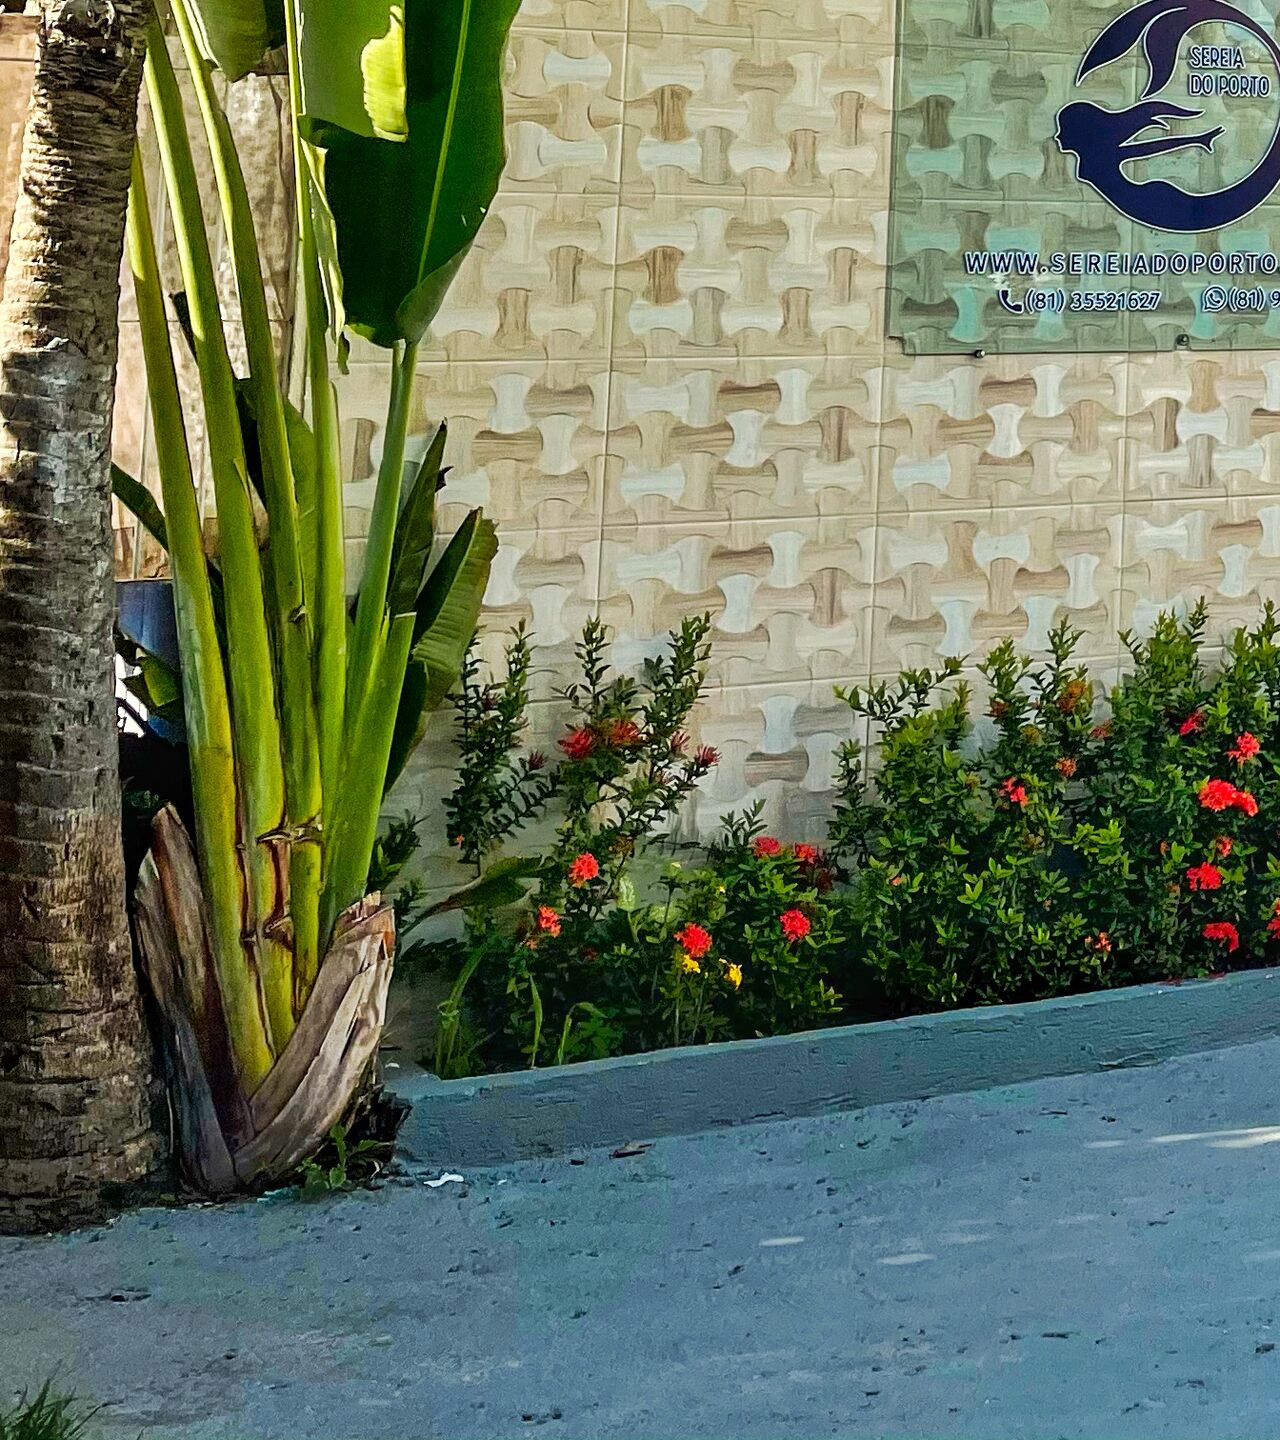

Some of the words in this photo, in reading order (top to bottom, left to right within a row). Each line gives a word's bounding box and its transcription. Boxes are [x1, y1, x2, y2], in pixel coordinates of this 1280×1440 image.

[1190, 46, 1245, 69] SEREIA
[1189, 74, 1214, 95] DO
[1218, 74, 1270, 97] PORTO
[1025, 288, 1065, 313] (81)
[1070, 291, 1161, 311] 35521627
[1228, 286, 1265, 311] (81)
